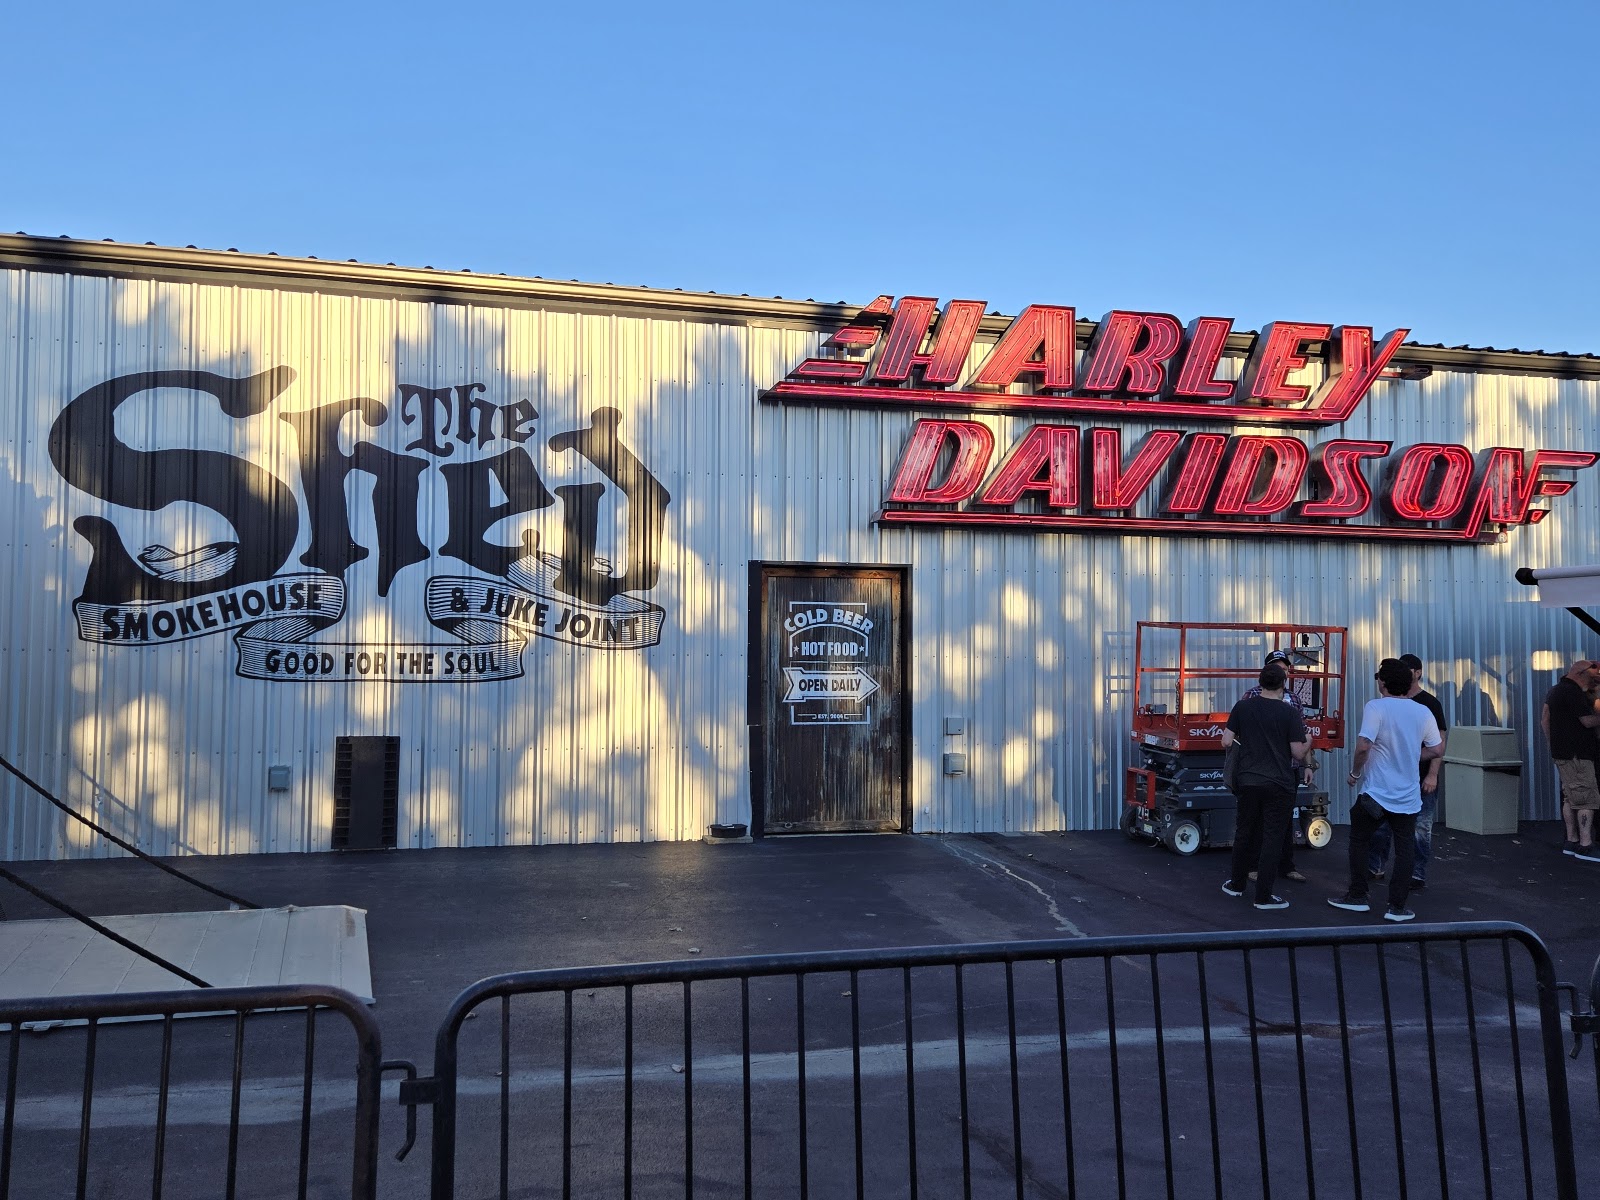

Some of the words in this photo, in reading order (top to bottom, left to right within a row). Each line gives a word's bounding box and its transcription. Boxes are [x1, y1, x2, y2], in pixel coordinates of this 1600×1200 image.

[862, 296, 1411, 421] HARLEY
[398, 383, 540, 457] The
[48, 365, 670, 605] Shed
[884, 418, 1598, 539] DAVIDSON
[102, 582, 322, 641] SMOKEHOUSE
[450, 586, 469, 612] &
[480, 588, 549, 627] JUKE
[555, 608, 640, 643] JOINT
[784, 608, 828, 632] COLD
[833, 608, 874, 634] BEER
[265, 649, 335, 675] GOOD
[344, 651, 387, 675] FOR
[396, 652, 434, 675] THE
[444, 651, 500, 673] SOUL
[801, 641, 826, 656] HOT
[827, 641, 859, 656] FOOD
[798, 678, 829, 692] OPEN
[831, 678, 862, 692] DAILY
[1189, 724, 1225, 737] SKYJA
